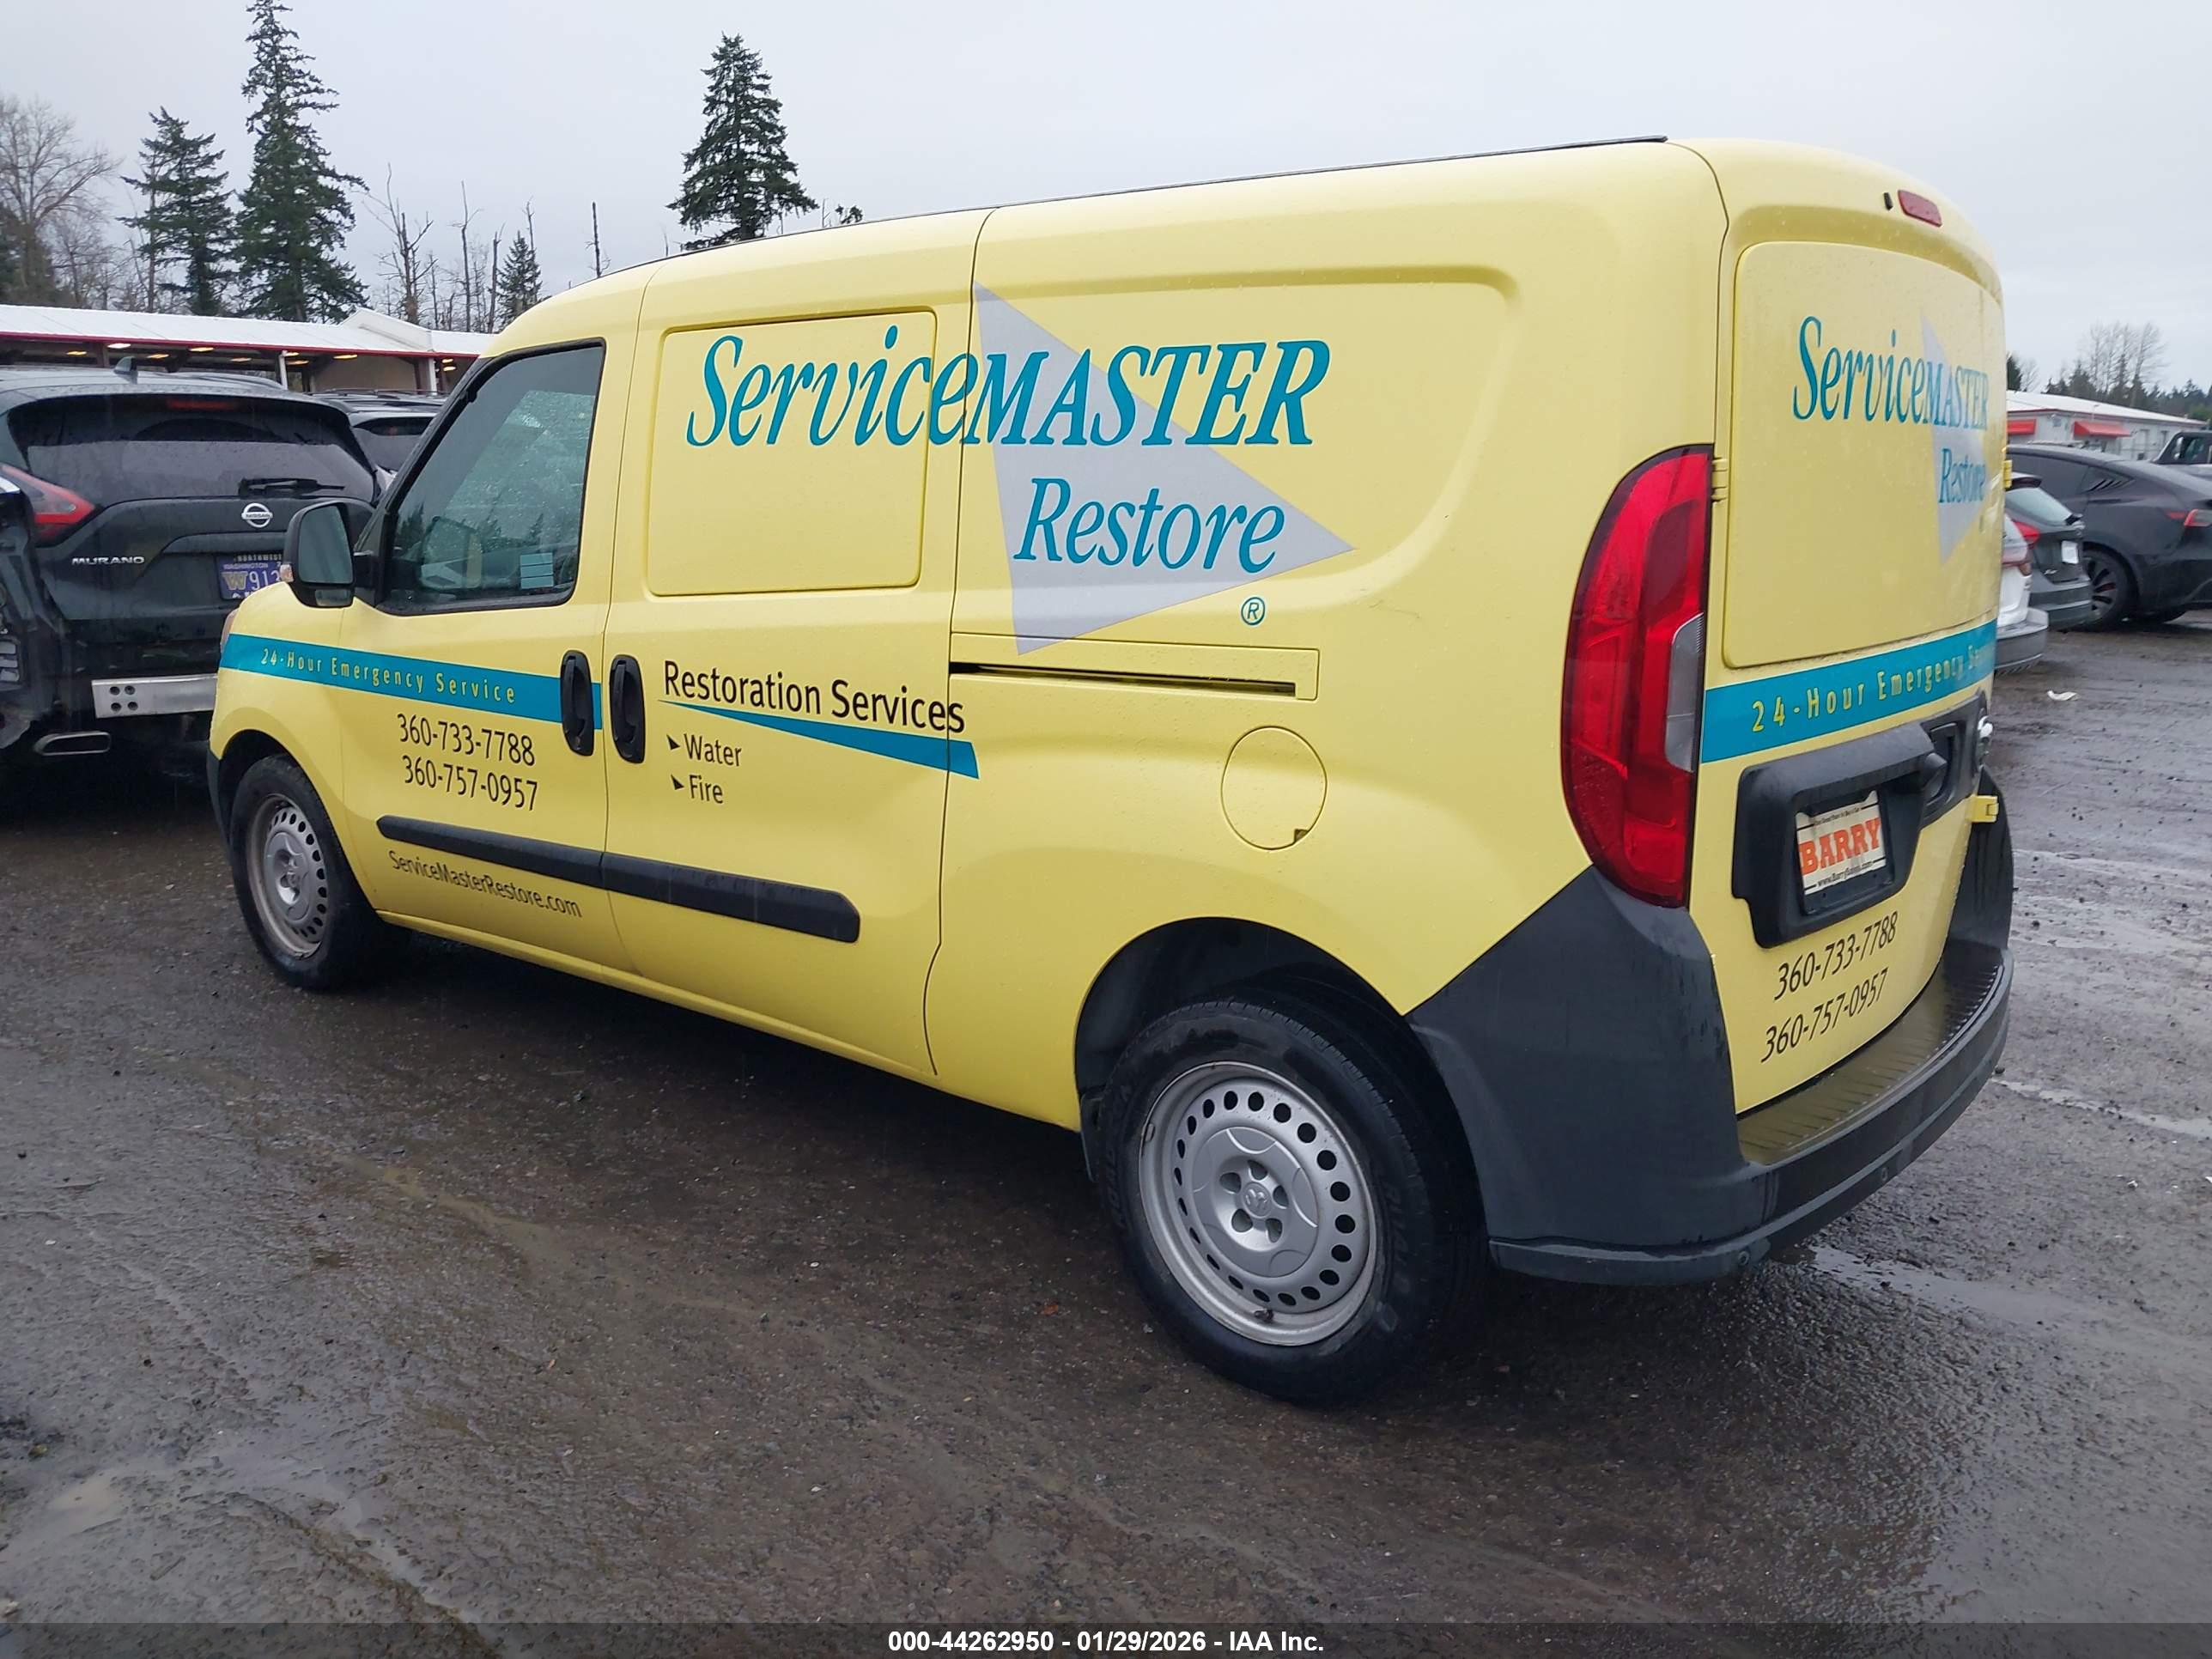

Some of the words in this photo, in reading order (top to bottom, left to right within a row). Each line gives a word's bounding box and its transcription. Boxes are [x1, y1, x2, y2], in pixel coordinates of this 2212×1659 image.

[686, 325, 1331, 447] ServiceMASTER
[1793, 316, 1988, 430] ServiceMASTER
[1939, 448, 1986, 503] Restore
[1013, 477, 1285, 573] Restore
[71, 556, 145, 566] MURANO
[261, 647, 322, 672] 24-Hour
[331, 658, 423, 693] Emergency
[436, 673, 516, 703] Service
[665, 660, 821, 714] Restoration
[831, 679, 965, 733] Services
[1752, 684, 1864, 732] 24-Hour
[1877, 654, 1964, 700] Emergency
[398, 714, 535, 766] 360-733-7788
[684, 733, 742, 767] Water
[402, 755, 538, 811] 360-757-0957
[690, 775, 724, 804] Fire
[1799, 817, 1881, 875] BARRY
[388, 850, 582, 917] ServiceMasterRestore.com
[1774, 911, 1898, 1000] 360-733-7788
[1761, 967, 1888, 1063] 360-757-0957
